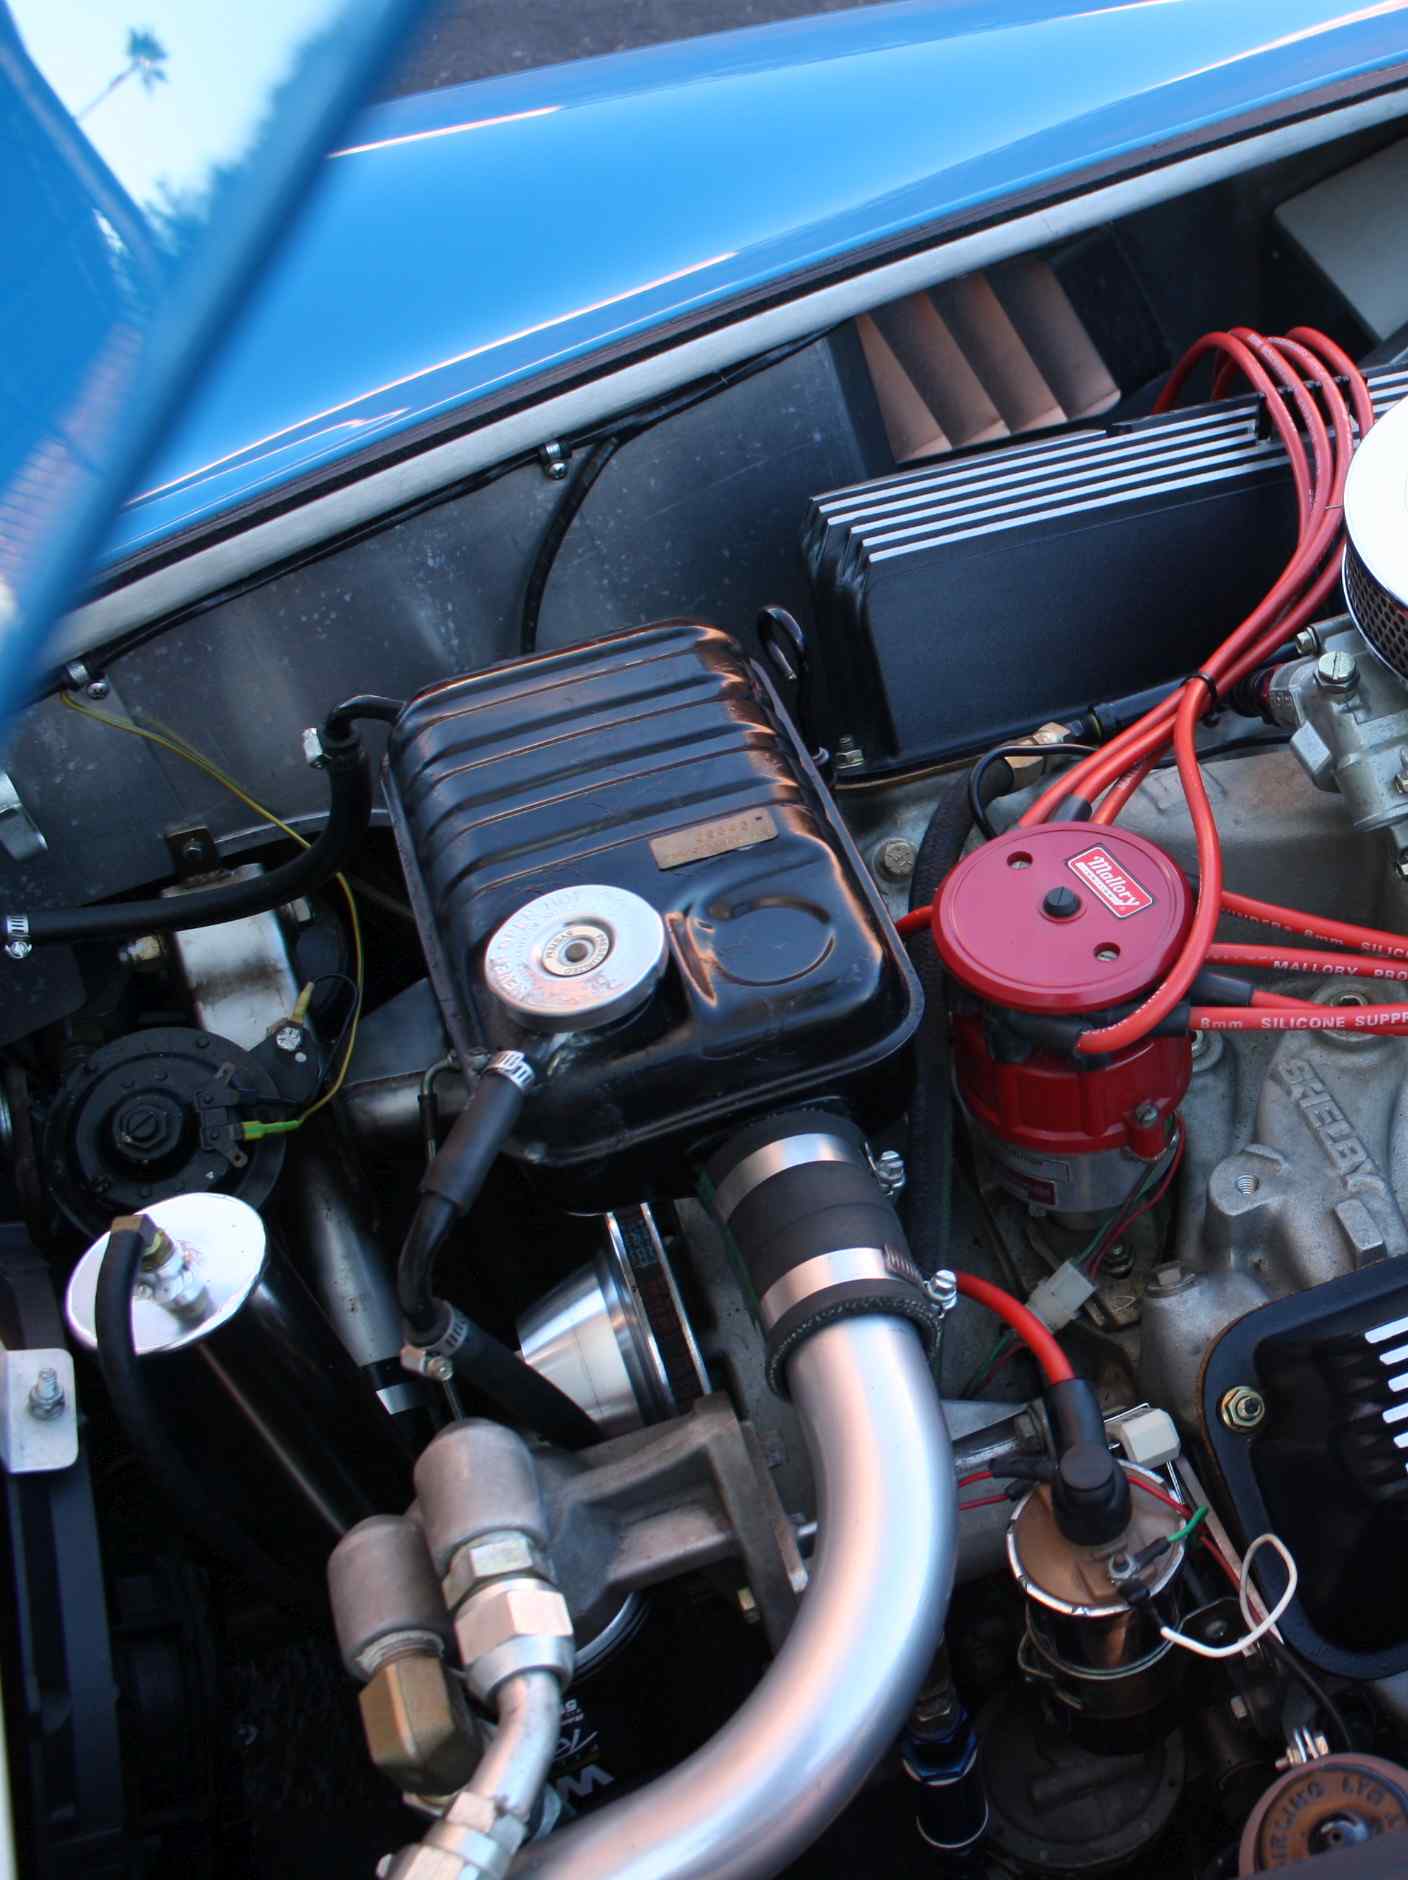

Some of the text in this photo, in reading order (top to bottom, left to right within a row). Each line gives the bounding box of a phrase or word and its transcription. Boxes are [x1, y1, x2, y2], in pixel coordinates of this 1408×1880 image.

[1085, 855, 1141, 906] Mallory
[1272, 959, 1359, 976] MALLORY
[1373, 968, 1408, 983] PRO
[1200, 1016, 1244, 1030] 8mm
[1260, 1016, 1346, 1030] SILICONE
